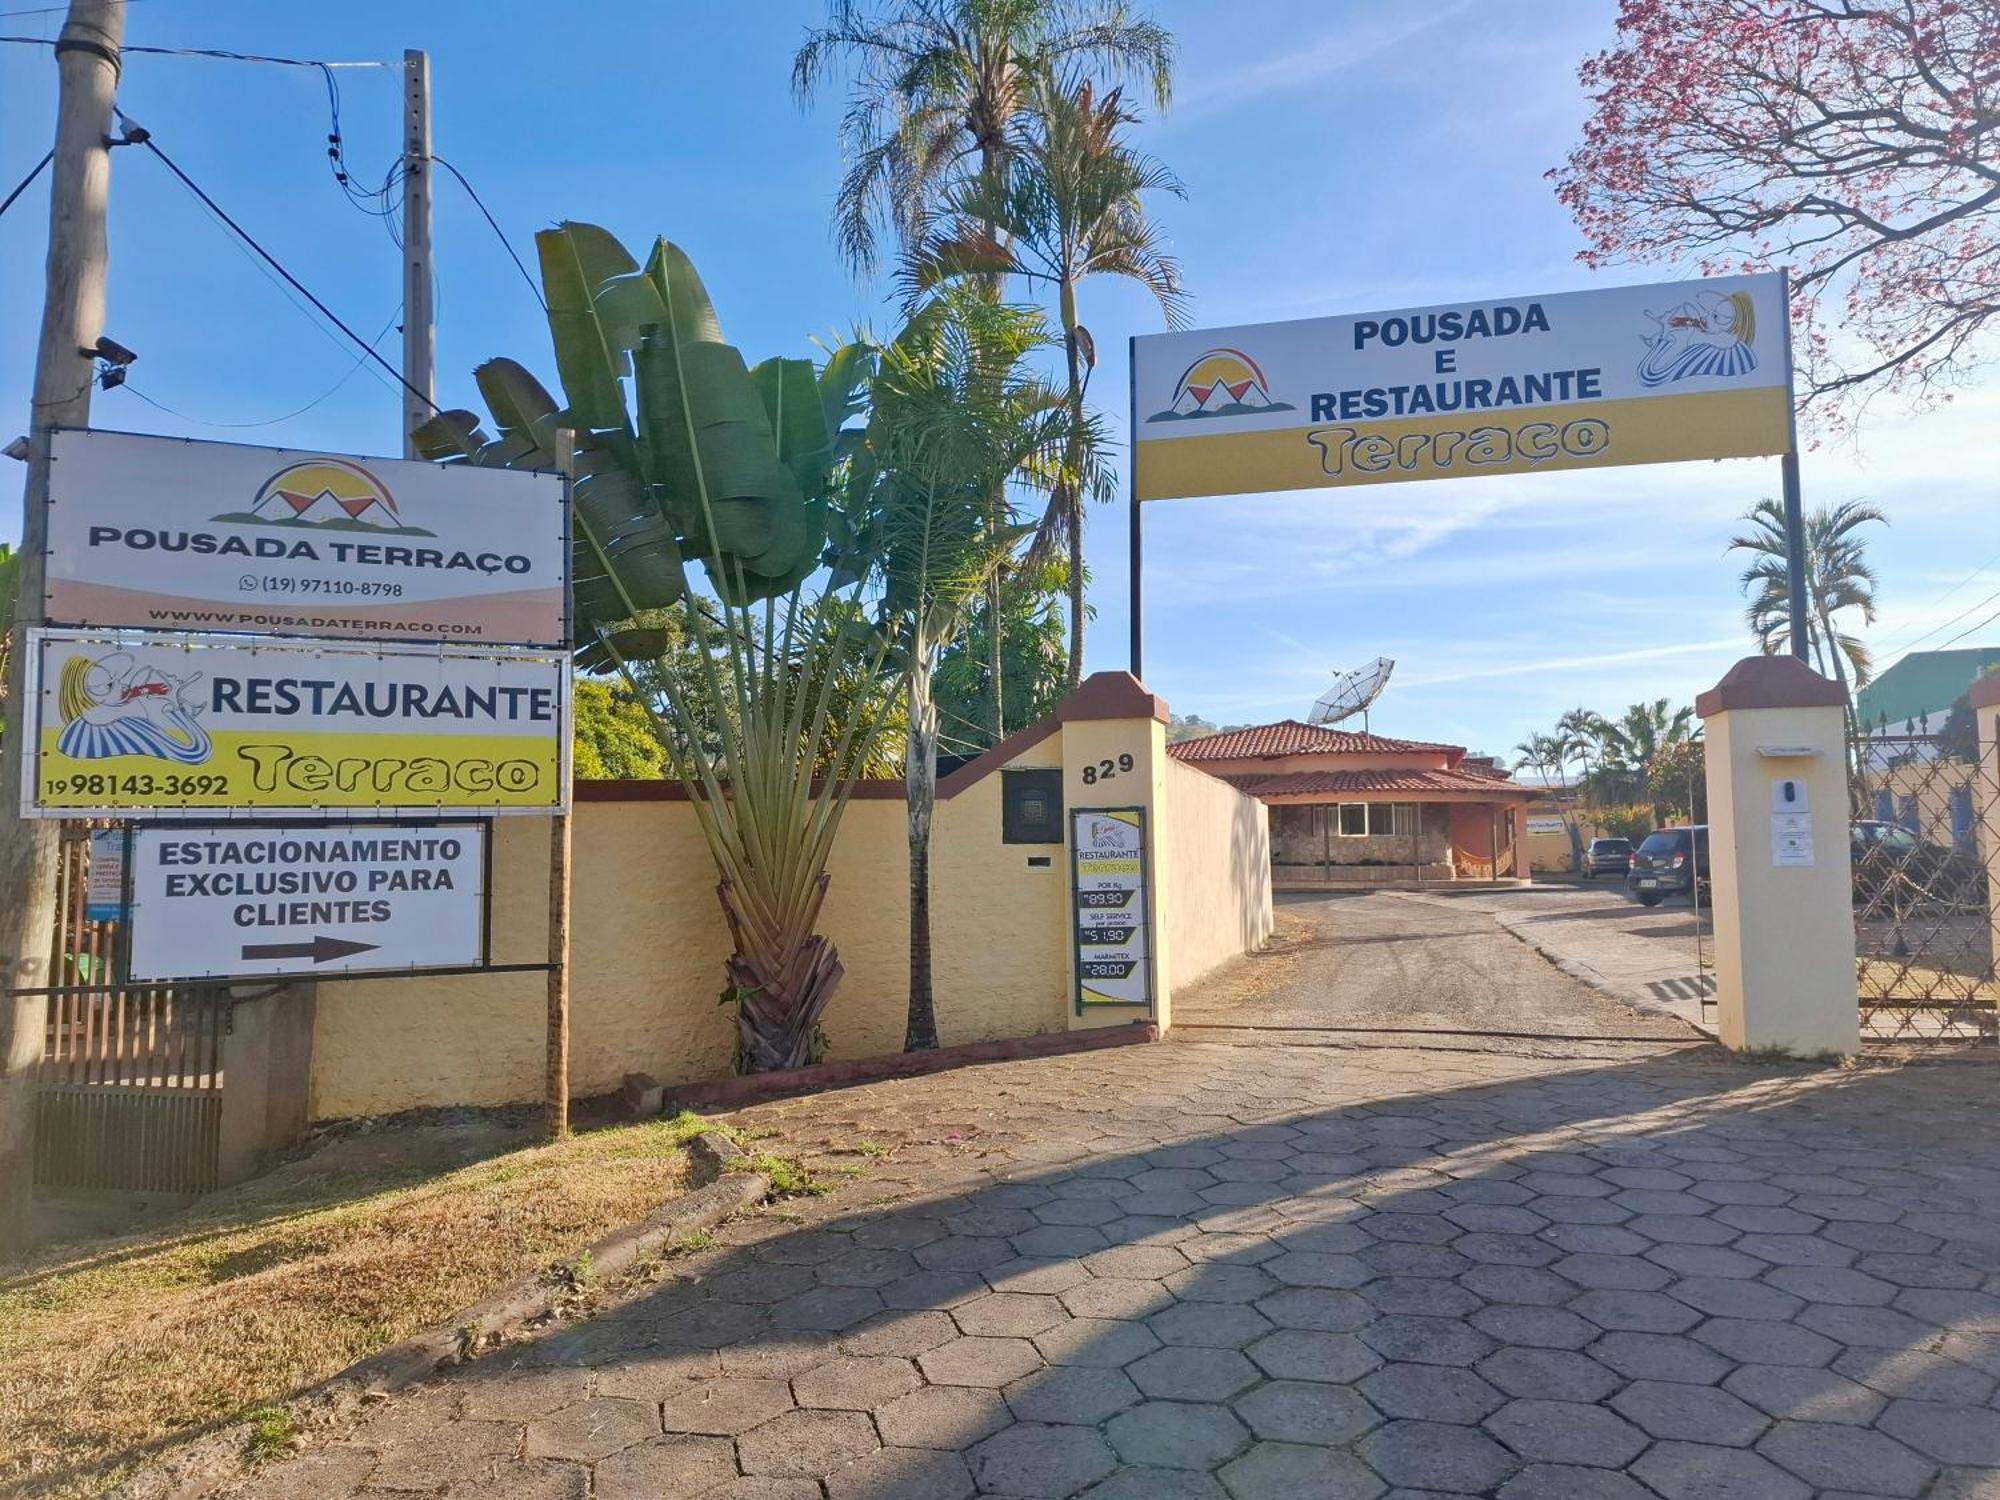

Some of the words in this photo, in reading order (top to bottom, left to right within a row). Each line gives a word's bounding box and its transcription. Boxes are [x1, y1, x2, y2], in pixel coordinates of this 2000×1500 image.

[1353, 303, 1551, 350] POUSADA
[1435, 350, 1456, 373] E
[1310, 368, 1602, 422] RESTAURANTE
[88, 526, 320, 562] POUSADA
[329, 543, 532, 576] TERRAÇO
[262, 576, 296, 594] (19)
[300, 579, 403, 597] 97110-8798
[212, 677, 552, 721] RESTAURANTE
[1082, 753, 1134, 785] 829
[47, 780, 67, 795] 19
[70, 774, 229, 796] 98143-3692
[159, 839, 461, 865] ESTACIONAMENTO
[1079, 850, 1139, 860] RESTAURANTE
[166, 870, 357, 897] EXCLUSIVO
[368, 869, 454, 891] PARA
[233, 901, 391, 926] CLIENTES
